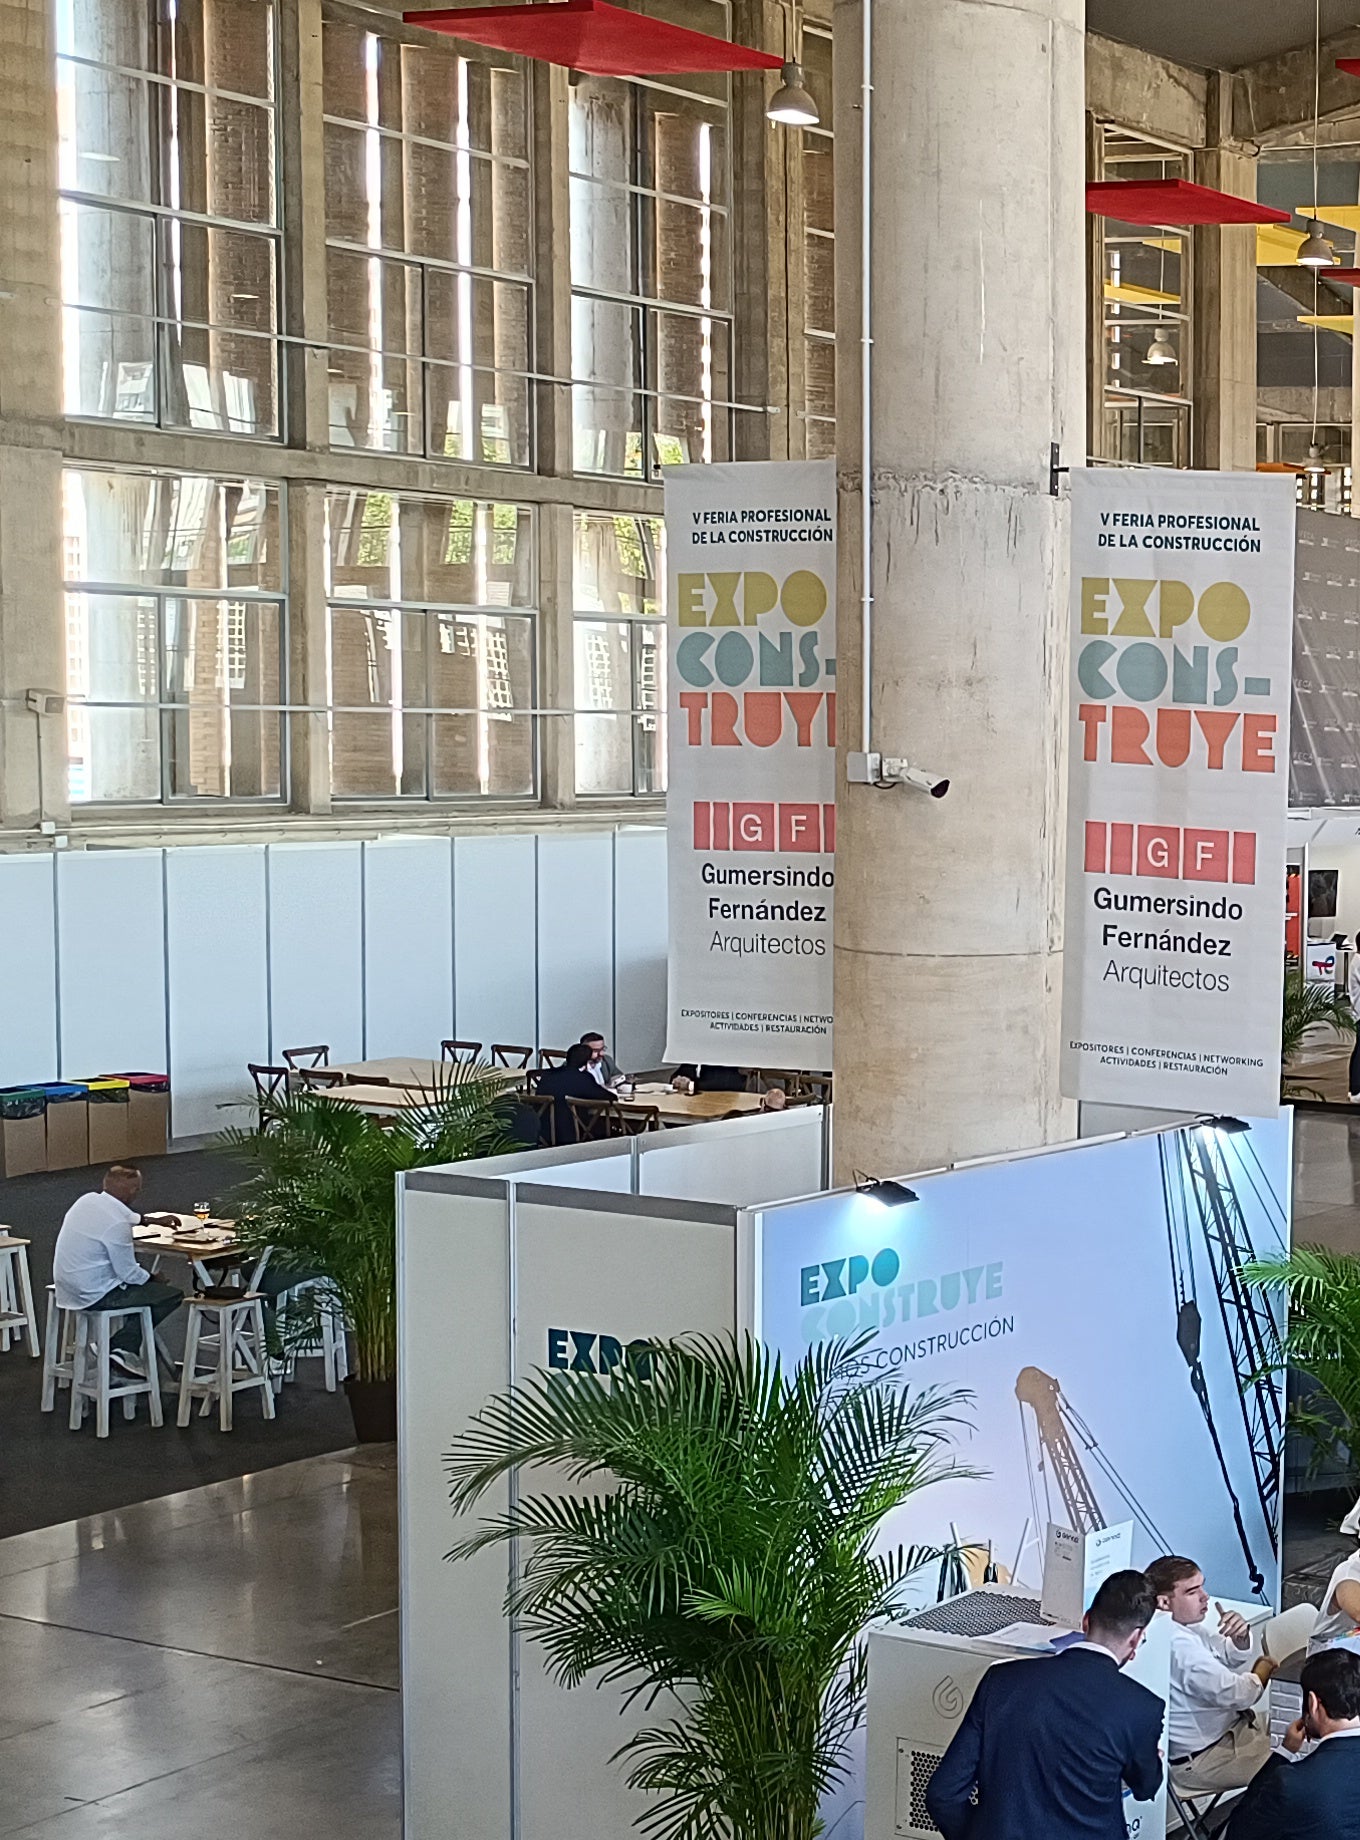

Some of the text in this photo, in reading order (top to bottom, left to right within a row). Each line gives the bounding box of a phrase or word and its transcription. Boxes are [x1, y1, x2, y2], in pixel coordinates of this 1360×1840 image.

[692, 508, 831, 524] V FERIA PROFESIONAL
[1100, 513, 1260, 531] V FERIA PROFESIONAL
[692, 526, 832, 544] DE LA CONSTRUCCIÓN
[1098, 533, 1260, 552] DE LA CONSTRUCCIÓN
[678, 570, 827, 627] EXPO
[1081, 577, 1250, 642] EXPO
[1078, 640, 1271, 706] CONS-
[1079, 704, 1276, 773] TRUYE
[701, 862, 835, 888] Gumersindo
[708, 897, 826, 922] Fernández
[1093, 887, 1243, 920] Gumersindo
[709, 931, 826, 960] Arquitectos
[1103, 924, 1231, 957] Fernández
[1103, 960, 1230, 993] Arquitectos
[681, 1009, 834, 1023] EXPOSITORES CONFERENCIAS NETWO
[710, 1021, 826, 1034] ACTIVIDADES RESTAURACIÓN
[1069, 1040, 1263, 1067] EXPOSITORES CONFERENCIAS NETWORKING
[1100, 1056, 1230, 1075] ACTIVIDADES RESTAURACIÓN
[800, 1248, 900, 1306] EXPO
[802, 1261, 1003, 1345] CONSTRUYE
[875, 1316, 1015, 1370] CONSTRUCCIÓN
